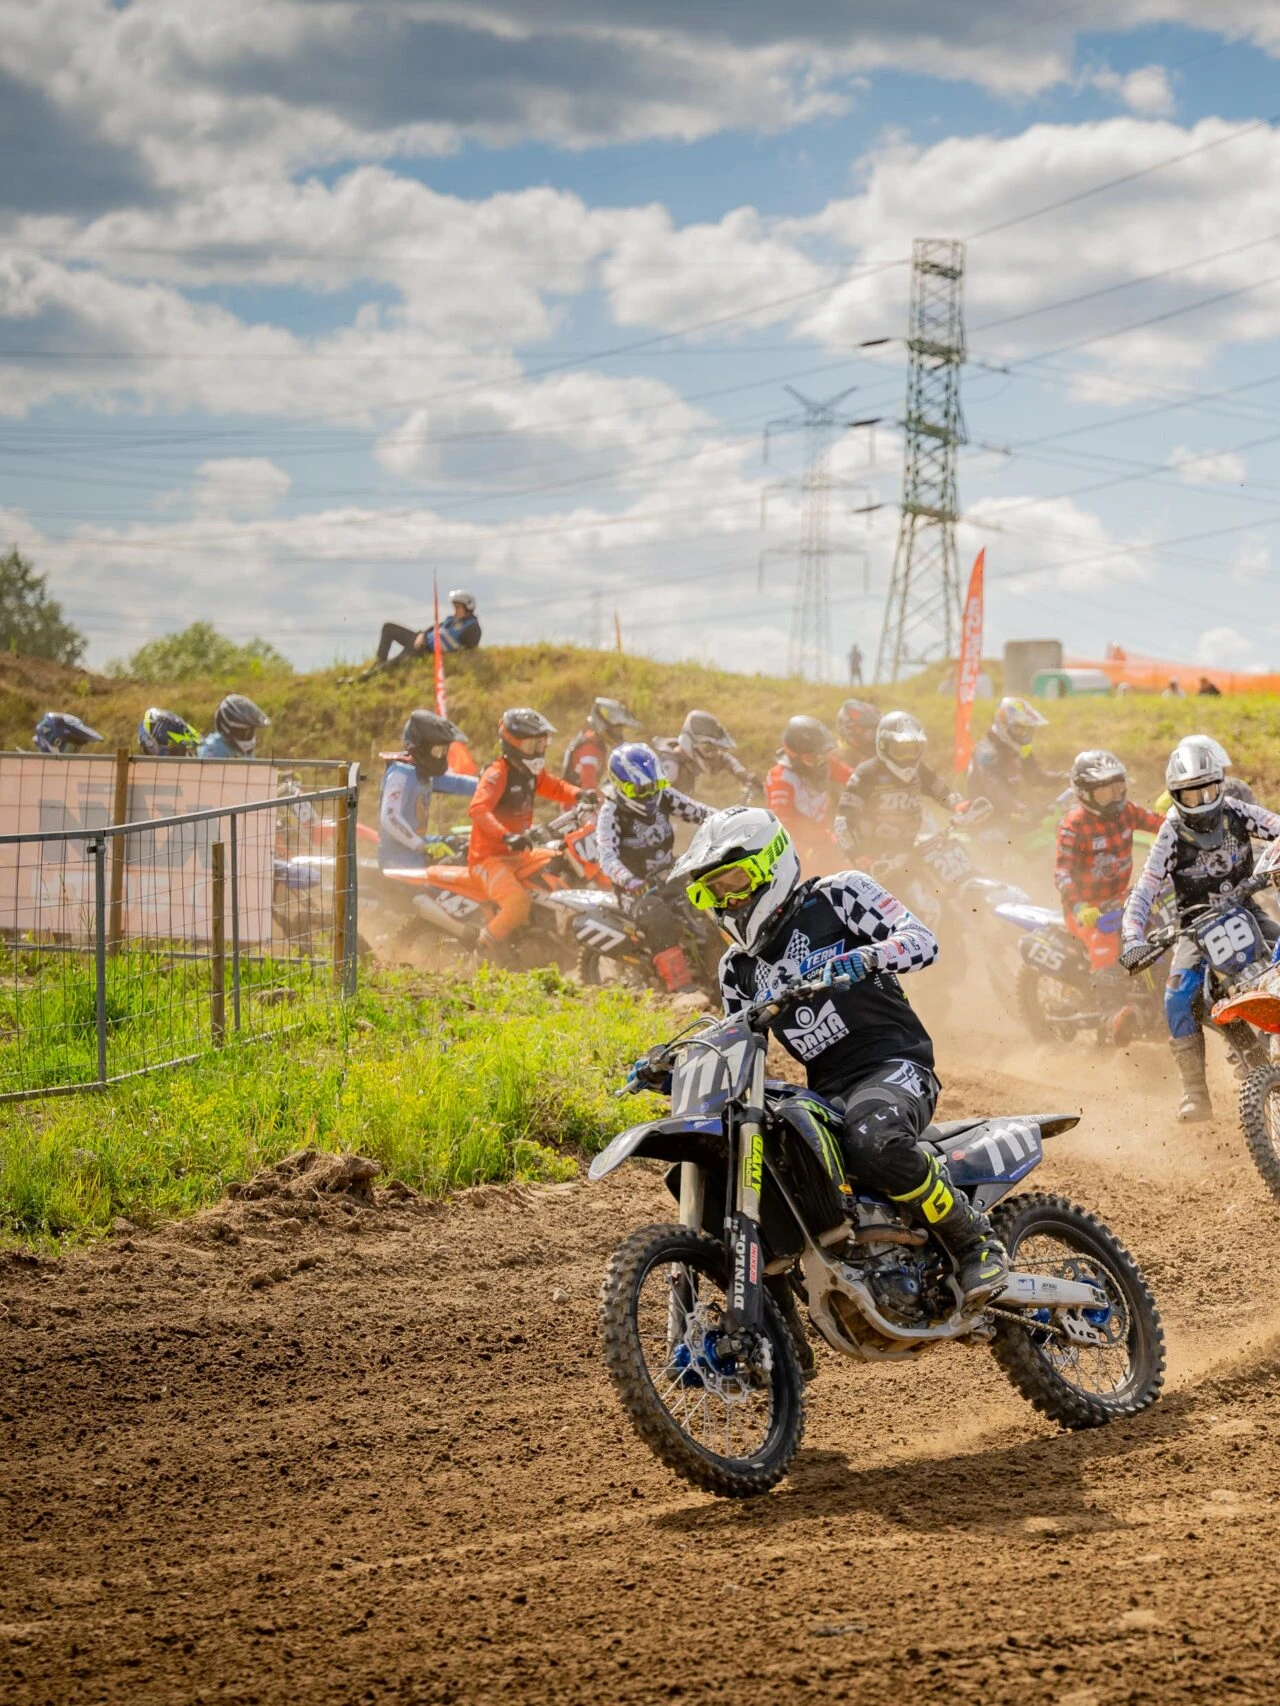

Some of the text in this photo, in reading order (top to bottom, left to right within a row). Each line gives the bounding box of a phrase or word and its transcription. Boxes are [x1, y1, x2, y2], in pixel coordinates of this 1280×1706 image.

[806, 946, 837, 969] TEAM
[1204, 913, 1255, 966] 68
[790, 1012, 846, 1055] DANA
[857, 1105, 899, 1134] FLY
[749, 1242, 758, 1286] BRAKING
